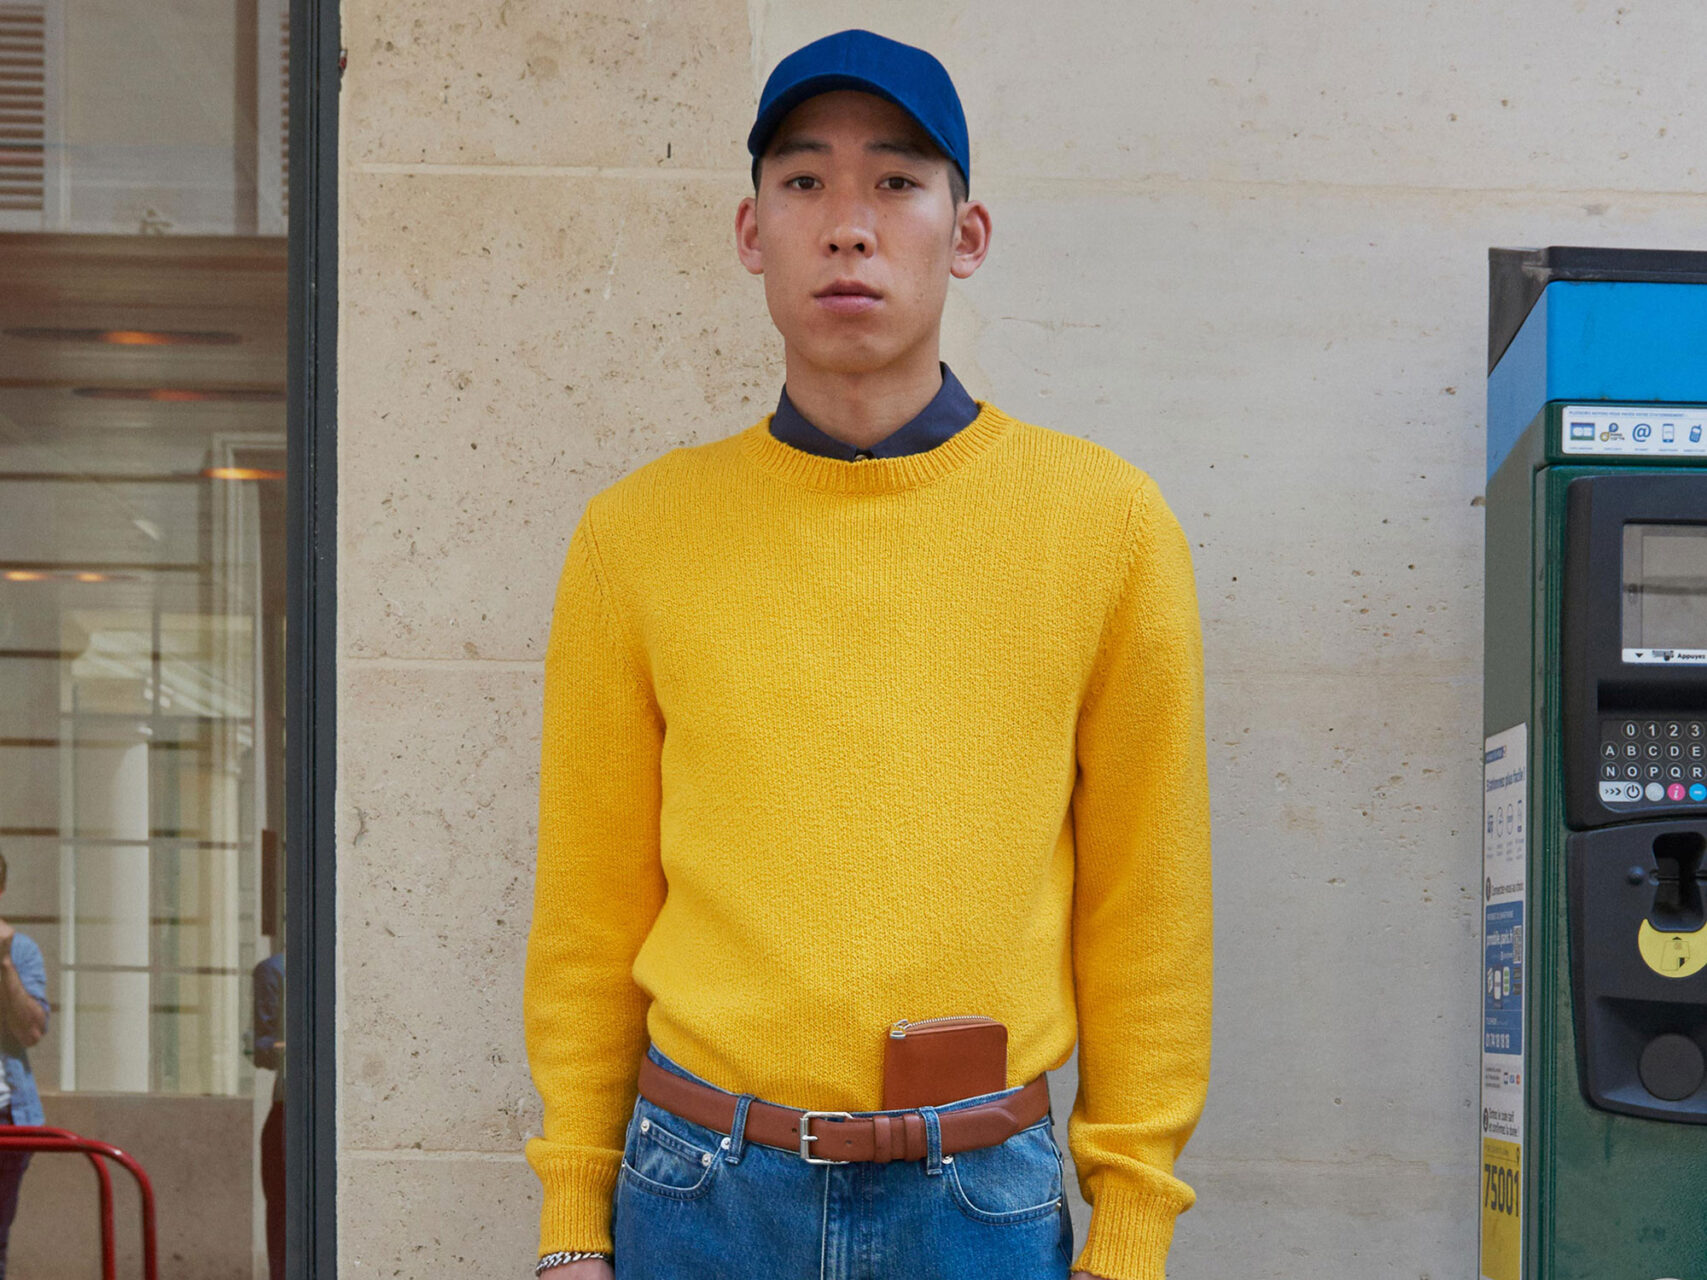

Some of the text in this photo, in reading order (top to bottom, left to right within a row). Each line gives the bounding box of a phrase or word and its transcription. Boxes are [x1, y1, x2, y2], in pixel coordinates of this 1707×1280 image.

[1626, 724, 1700, 736] 0 1 2 3
[1605, 746, 1701, 756] A B C D E
[1606, 766, 1702, 778] N O P Q R
[1484, 1163, 1520, 1217] 75001
